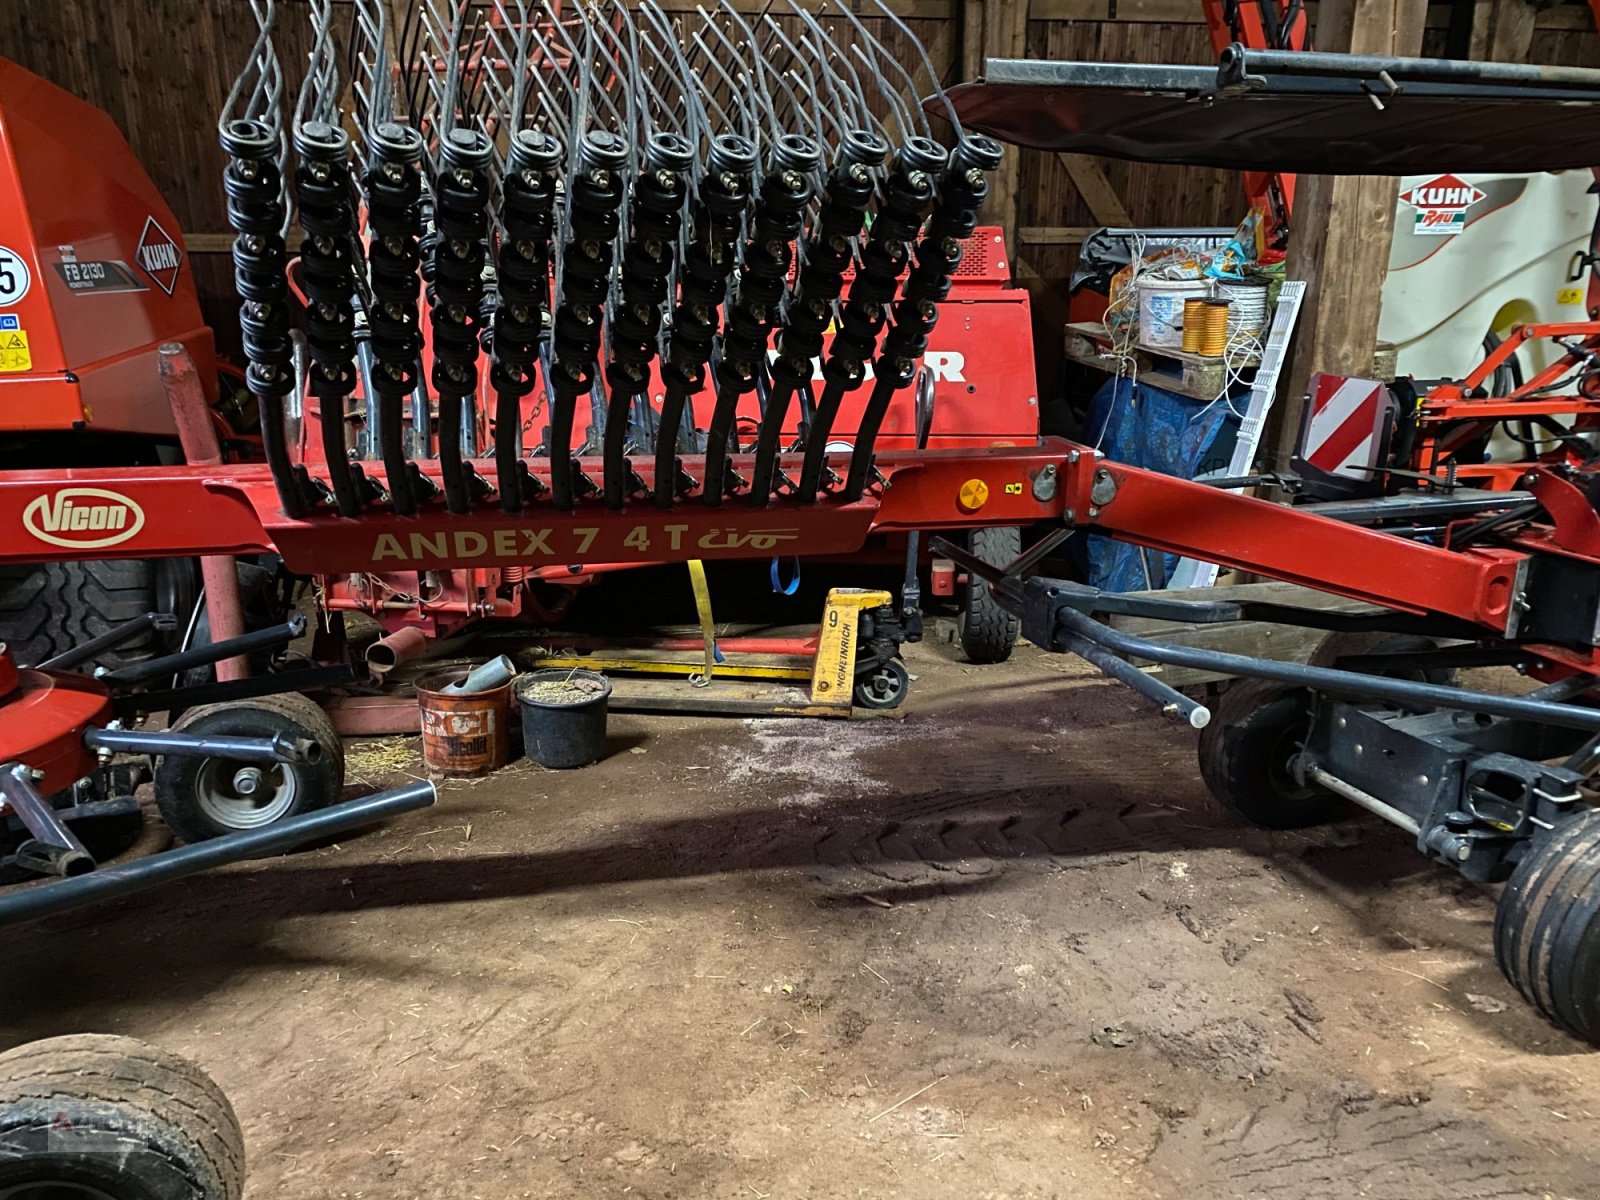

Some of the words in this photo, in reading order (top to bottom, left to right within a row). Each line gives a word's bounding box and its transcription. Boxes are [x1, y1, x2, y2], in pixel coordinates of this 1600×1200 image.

[1411, 187, 1475, 204] KUHN
[142, 243, 178, 272] KUHN
[64, 264, 81, 281] FB
[81, 262, 105, 280] 2130
[41, 493, 127, 532] Vicon
[371, 527, 556, 561] ANDEX
[573, 527, 600, 554] 7
[623, 525, 651, 552] 4
[664, 524, 689, 550] T
[829, 610, 838, 628] 9
